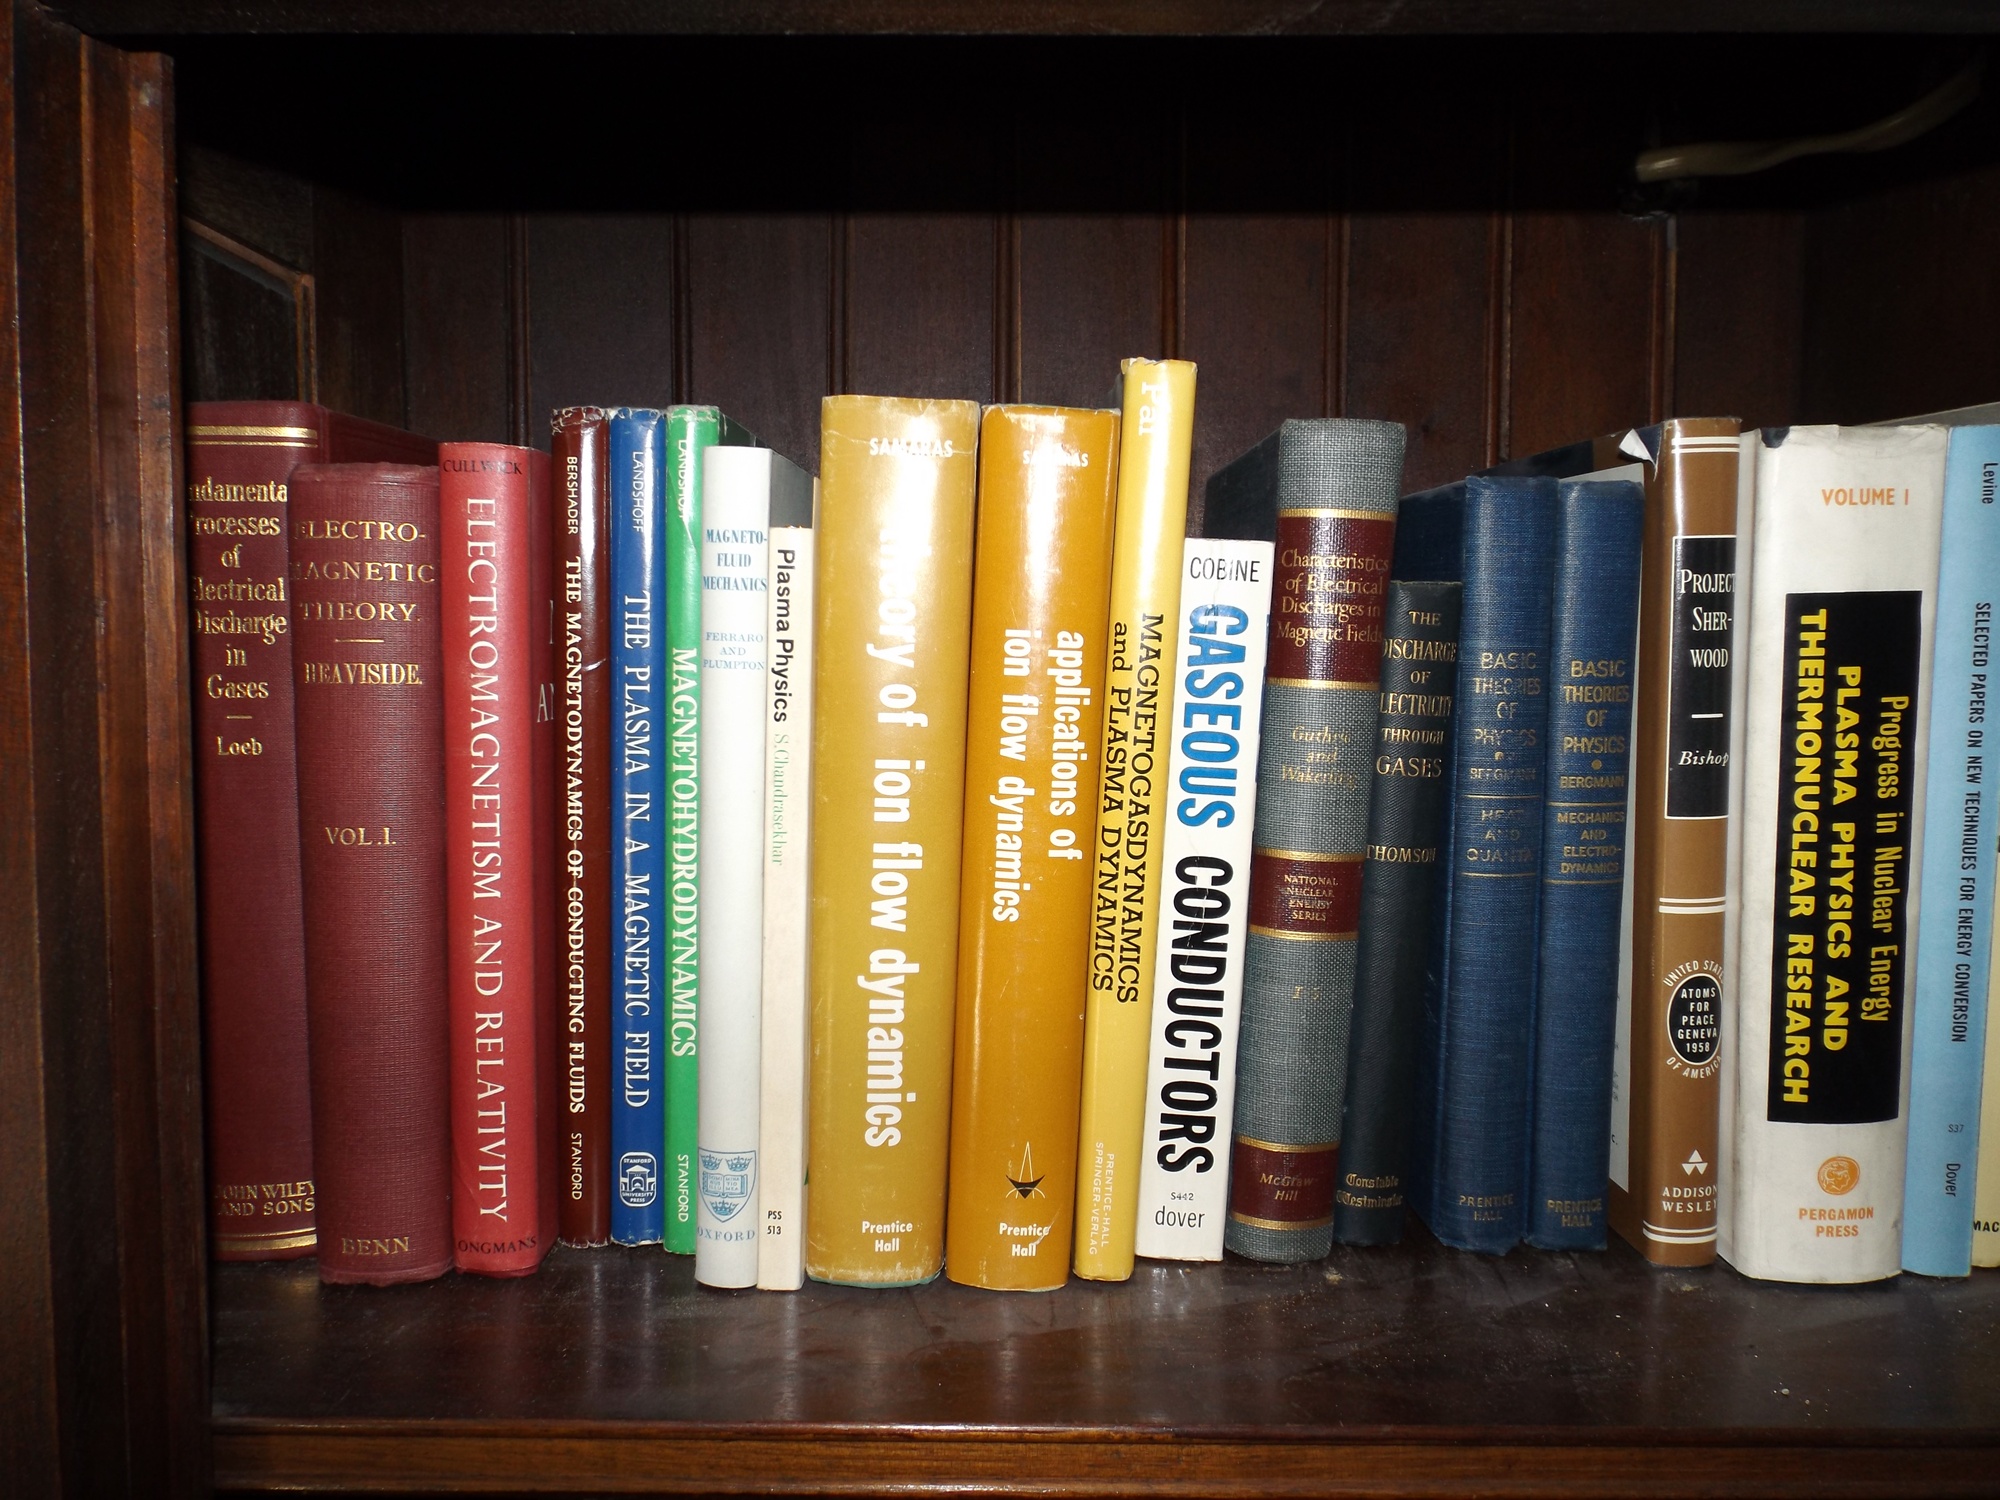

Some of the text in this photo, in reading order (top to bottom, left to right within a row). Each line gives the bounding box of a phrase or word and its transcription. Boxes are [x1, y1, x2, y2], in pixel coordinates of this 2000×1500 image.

[632, 451, 646, 533] LANDSHOFF
[1981, 461, 1999, 505] Levine
[566, 456, 579, 535] BERSHADER
[1821, 487, 1896, 507] VOLUME
[189, 514, 282, 536] rocesses
[706, 529, 768, 545] MAGNETO-
[221, 543, 243, 569] of
[716, 552, 752, 568] FLUID
[1281, 548, 1390, 572] Characteristics
[1189, 557, 1261, 583] COBINE
[703, 576, 768, 592] MECHANICS
[1285, 573, 1383, 596] of Electrical
[1281, 596, 1381, 623] Discharges in
[1408, 610, 1442, 627] THE
[705, 631, 764, 643] FERRARO
[771, 549, 796, 723] Plasma Physics
[1276, 621, 1344, 648] Magnetic
[225, 645, 248, 667] in
[719, 646, 747, 656] AND
[1481, 651, 1537, 670] BASIC
[1690, 648, 1730, 668] WOOD
[703, 659, 766, 671] PLUMPTON
[1570, 659, 1627, 679] BASIC
[207, 674, 269, 700] Gases
[1410, 670, 1432, 684] OF
[1563, 684, 1630, 704] THEORIES
[1496, 701, 1519, 719] OF
[1585, 708, 1608, 728] OF
[216, 735, 263, 757] Loeb
[1047, 630, 1092, 861] applications of
[1381, 727, 1445, 745] THROUGH
[1563, 735, 1626, 755] PHYSICS
[1376, 754, 1442, 778] GASES
[1678, 750, 1730, 768] Bishop
[990, 628, 1042, 924] ion flow dynamics
[1559, 775, 1625, 790] BERGMANN
[1093, 622, 1134, 993] and PLASMA DYNAMICS
[1116, 612, 1164, 1004] MAGNETOGASDYNAMICS
[1557, 811, 1625, 825] MECHANICS
[1951, 602, 1992, 1043] SELECTED PAPERS ON NEW TECHNIQUES FOR ENERGY CONVERSION
[566, 556, 586, 1114] THE MAGNETODYNAMICS OF CONDUCTING FLUIDS
[1580, 828, 1607, 841] AND
[466, 497, 509, 1222] ELECTROMAGNETISM AND RELATIVITY
[624, 590, 651, 1109] THE PLASMA IN A MAGNETIC FIELD
[671, 647, 698, 1057] MAGNETOHYDRODYNAMICS
[1366, 844, 1437, 863] THOMSON
[1563, 845, 1622, 858] ELECTRO-
[1783, 608, 1828, 1104] THERMONUCLEAR RESEARCH
[1823, 665, 1862, 1052] PLASMA PHYSICS AND
[1861, 695, 1910, 1023] Progress in Nuclear Energy
[1560, 861, 1620, 875] DYNAMICS
[1156, 603, 1249, 1174] GASEOUS CONDUCTORS
[1283, 874, 1339, 886] NATIONAL
[1286, 887, 1335, 898] NUCLEAR
[1288, 899, 1333, 910] ENERGY
[857, 684, 929, 1148] of ion flow dynamics
[1291, 910, 1327, 921] SERIES
[1663, 959, 1700, 988] UNITED
[1680, 986, 1717, 1000] ATOMS
[1689, 1001, 1710, 1013] FOR
[1681, 1014, 1715, 1027] PEACE
[1677, 1027, 1718, 1040] GENEVA
[1686, 1041, 1711, 1054] 1958
[1666, 1056, 1683, 1071] OF
[1947, 1123, 1965, 1134] S37
[571, 1133, 583, 1201] STANFORD
[677, 1154, 690, 1223] STANFORD
[1945, 1162, 1961, 1198] Dover
[621, 1191, 654, 1199] UNIVERSITY
[1089, 1141, 1105, 1256] SPRINGER-VERLAG
[1100, 1153, 1115, 1248] PRENTICE-HALL
[1274, 1189, 1299, 1202] Hill
[217, 1197, 316, 1217] AND SONS
[767, 1210, 782, 1220] PSS
[1547, 1198, 1603, 1214] PRENTICE
[1798, 1207, 1875, 1221] PERGAMON
[862, 1219, 914, 1234] Prentice
[1154, 1205, 1206, 1229] dover
[1561, 1214, 1593, 1228] HALL
[767, 1225, 782, 1236] 513
[999, 1222, 1051, 1237] Prentice
[1815, 1224, 1860, 1238] PRESS
[341, 1236, 411, 1256] BENN
[874, 1237, 901, 1253] Hall
[1011, 1243, 1037, 1257] Hall
